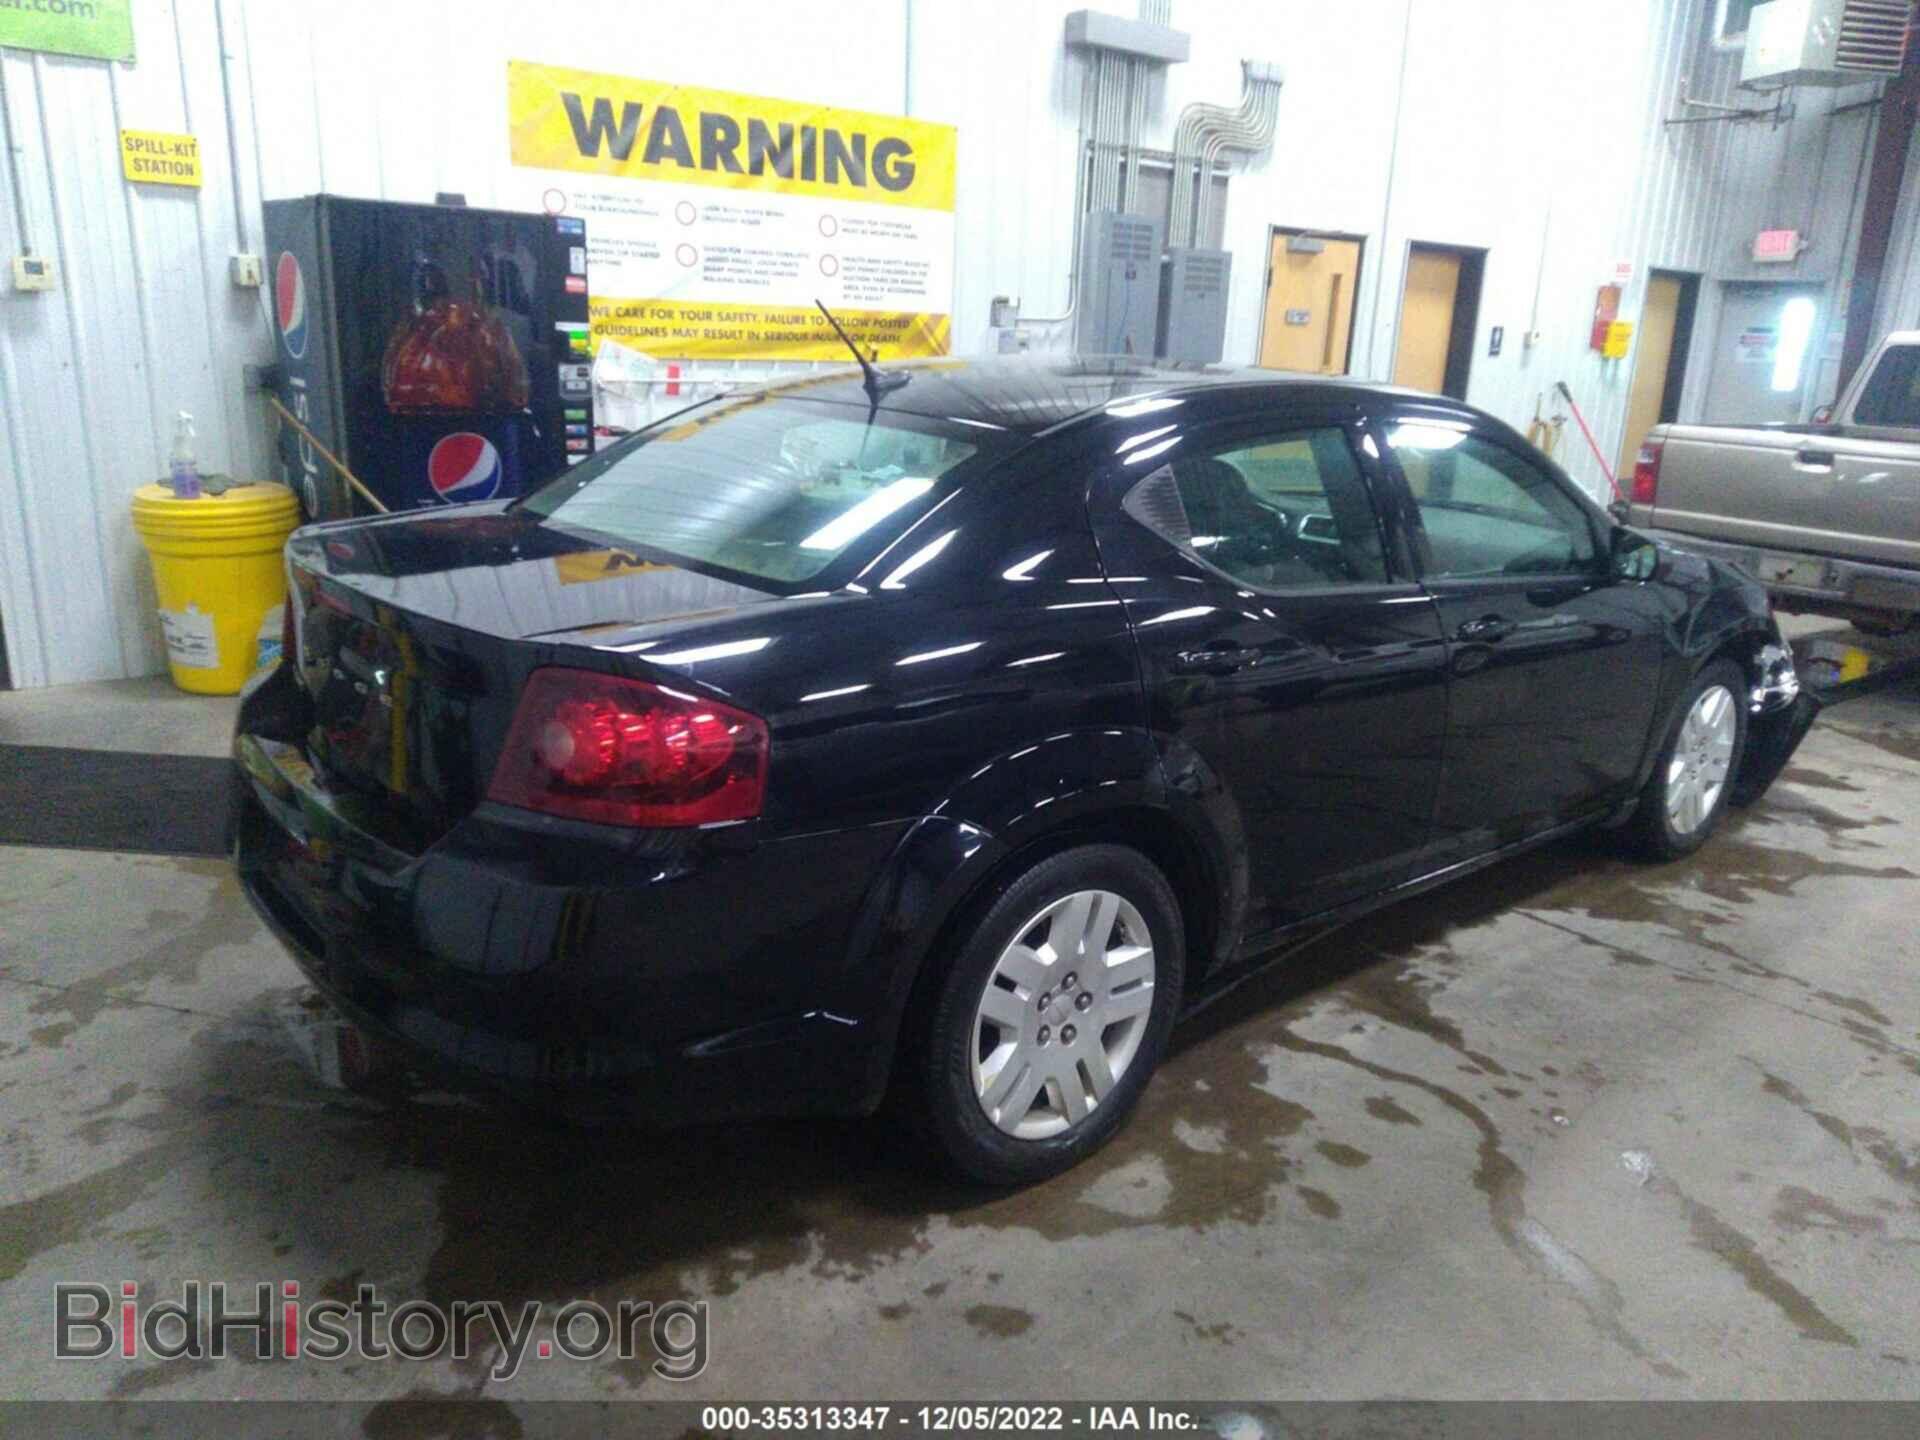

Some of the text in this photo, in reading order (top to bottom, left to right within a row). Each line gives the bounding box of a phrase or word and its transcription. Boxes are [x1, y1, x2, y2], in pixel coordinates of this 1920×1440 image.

[125, 137, 196, 157] SPILL-KIT
[561, 92, 915, 191] WARNING
[133, 157, 194, 176] STATION
[588, 304, 610, 317] WE
[616, 306, 645, 319] CARE
[651, 308, 674, 320] FOR
[680, 310, 712, 322] YOUR
[765, 313, 805, 325] FAILURE
[810, 316, 823, 326] TO
[873, 318, 910, 329] POSTED
[594, 323, 667, 338] GUIDELINES
[672, 327, 698, 338] MAY
[704, 328, 743, 340] RESULT
[748, 330, 760, 341] IN
[765, 331, 809, 342] SERIOUS
